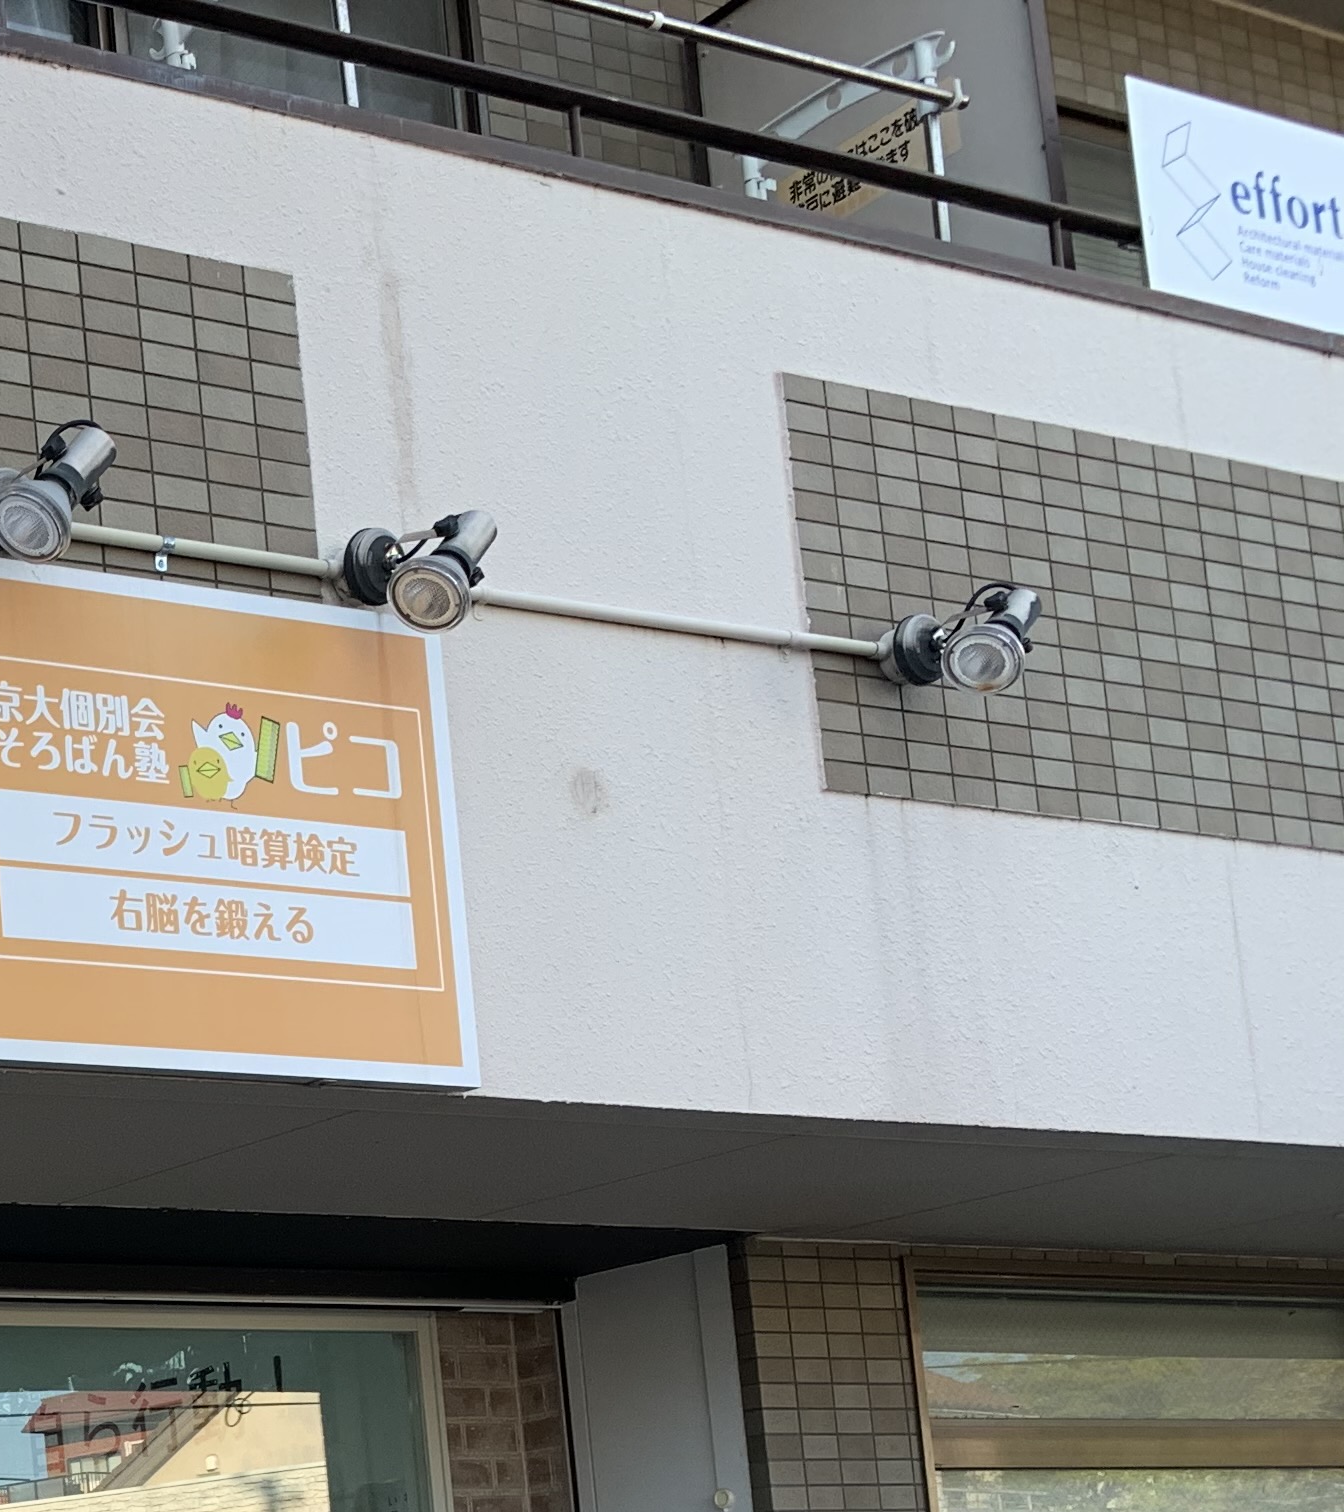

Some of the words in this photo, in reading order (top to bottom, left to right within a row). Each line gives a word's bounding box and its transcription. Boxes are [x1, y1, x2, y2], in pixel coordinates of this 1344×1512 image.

[1231, 171, 1344, 240] effort
[285, 720, 403, 800] ピコ
[52, 810, 360, 878] フラッシュ暗算検定
[109, 888, 315, 944] 右脳を鍛える
